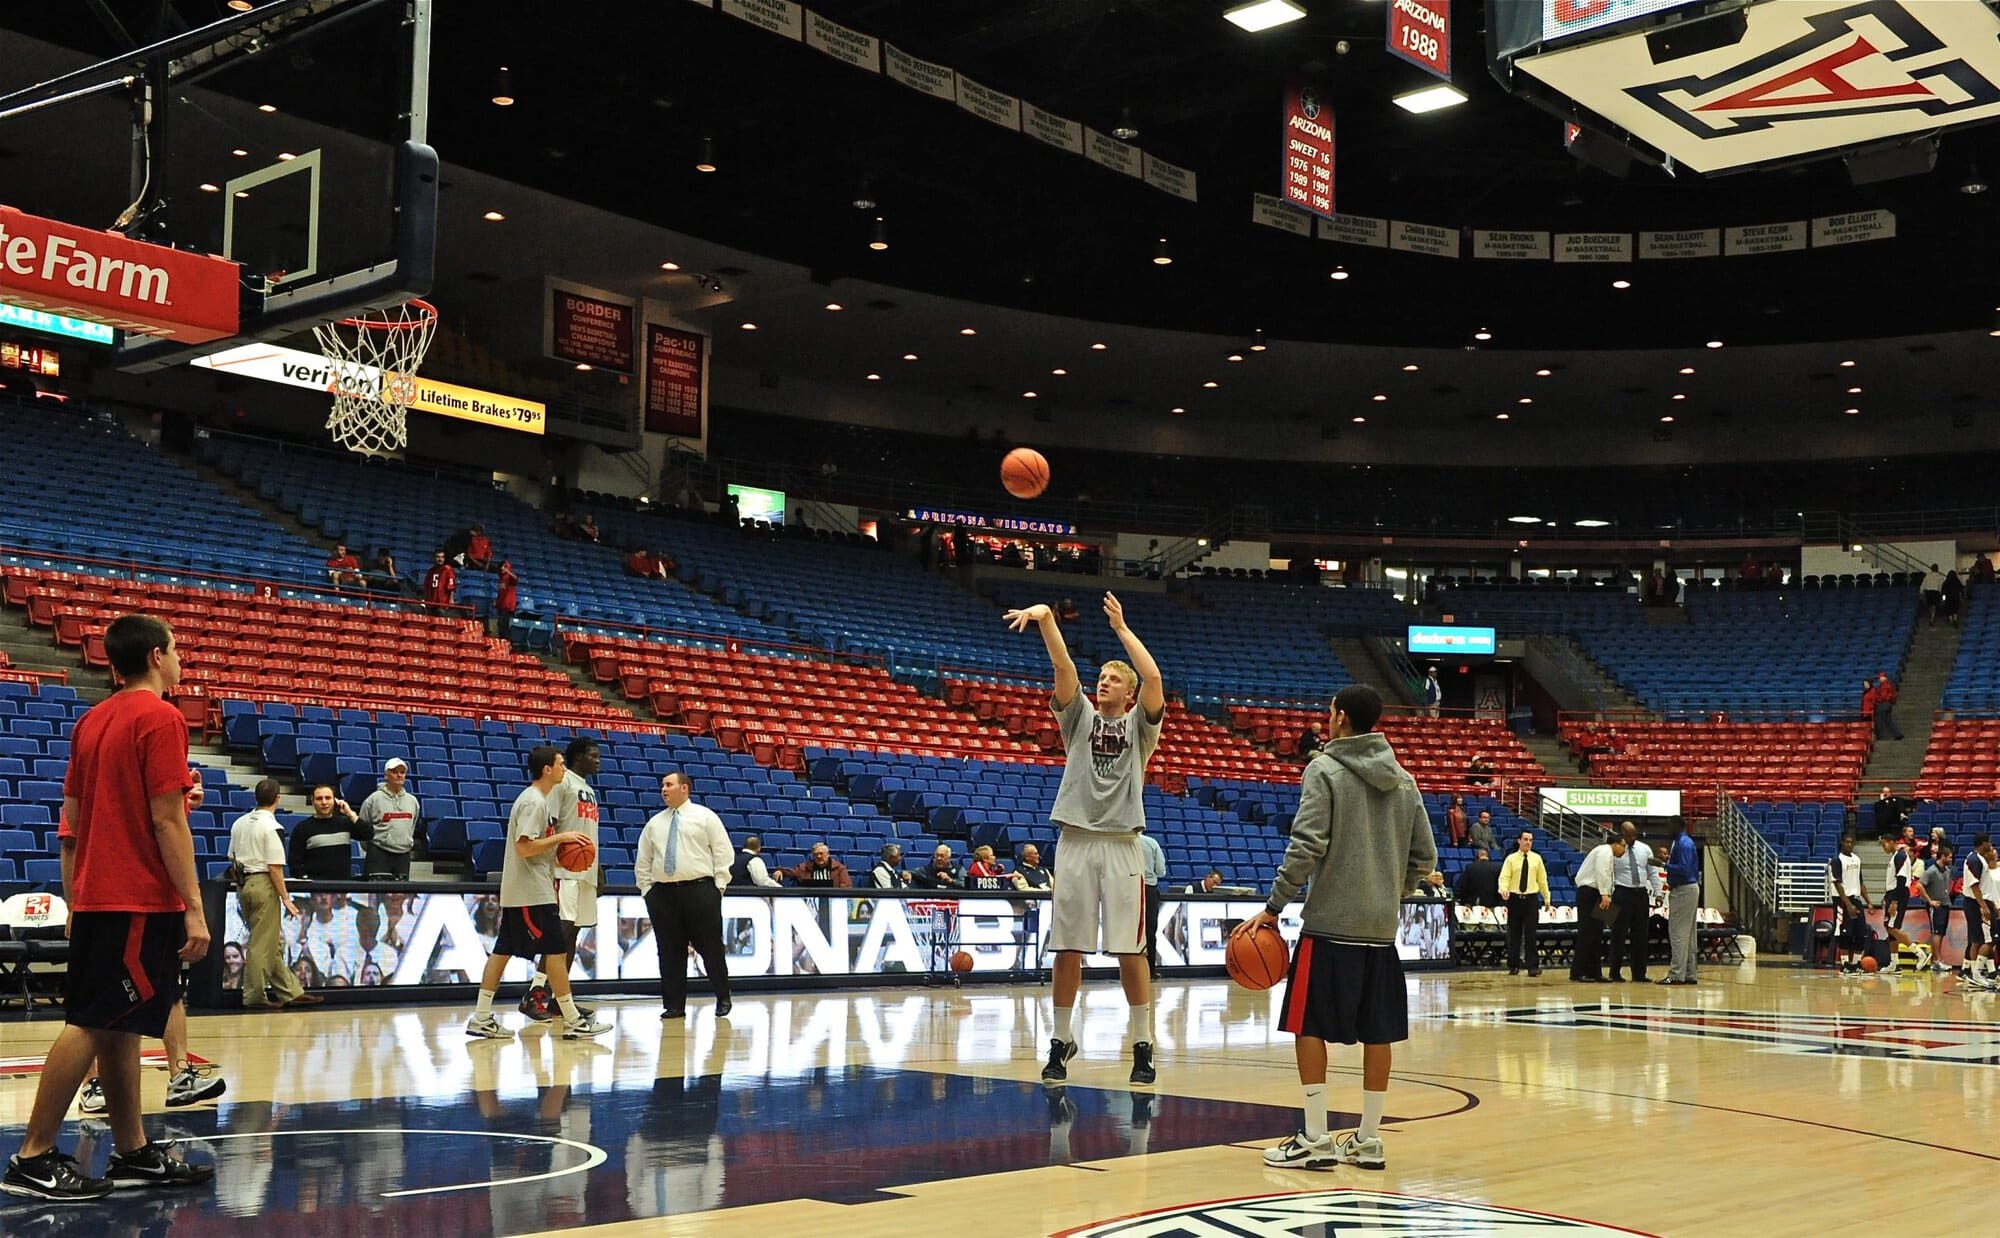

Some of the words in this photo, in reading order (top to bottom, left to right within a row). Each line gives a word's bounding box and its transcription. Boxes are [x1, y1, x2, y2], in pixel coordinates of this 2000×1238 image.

[1393, 0, 1446, 33] ARIZONA
[815, 30, 869, 58] M-BASKETBALL
[835, 25, 871, 48] GARDNER
[1401, 25, 1439, 61] 1988
[894, 62, 943, 87] M-BASKETBALL
[913, 57, 952, 80] JEFFERSON
[1289, 115, 1332, 143] ARIZONA
[1289, 139, 1319, 159] SWEET
[1320, 152, 1330, 165] 16
[1289, 156, 1308, 172] 1976
[1313, 164, 1330, 181] 1988
[1289, 171, 1308, 187] 1989
[1313, 179, 1329, 195] 1991
[1289, 186, 1308, 202] 1994
[1312, 194, 1330, 210] 1996
[1352, 216, 1377, 228] REEVES
[1828, 215, 1846, 228] BOB
[1847, 212, 1878, 225] ELLIOTT
[1328, 224, 1376, 238] M-BASKETBALL
[1405, 224, 1425, 235] CHRIS
[1427, 228, 1447, 239] MILLS
[1489, 232, 1508, 242] SEAN
[1510, 233, 1535, 242] ROOKS
[1654, 232, 1675, 242] SEAN
[1676, 231, 1705, 242] ELLIOTT
[1742, 226, 1767, 237] STEVE
[1768, 225, 1789, 235] KERR
[1823, 222, 1884, 237] M-BASKETBALL
[1400, 234, 1449, 248] M-BASKETBALL
[1567, 235, 1582, 245] JUD
[1583, 235, 1621, 245] BUECHLER
[1649, 241, 1708, 250] M-BASKETBALL
[1736, 235, 1794, 246] M-BASKETBALL
[1565, 245, 1622, 253] M-BASKETBALL
[41, 234, 169, 305] Farm
[567, 298, 621, 320] BORDER
[572, 314, 615, 329] CONFERENCE
[571, 333, 616, 348] CHAMPIONS
[587, 328, 617, 340] BASKETBALL
[653, 345, 697, 360] CONFERENCE
[659, 366, 690, 379] CHAMPIONS
[668, 360, 697, 373] BASKETBALL
[282, 362, 372, 396] verizon
[420, 389, 469, 411] Lifetime
[472, 400, 511, 420] Brakes
[921, 511, 986, 527] ARIZONA
[993, 518, 1064, 534] WILDCATS
[432, 573, 439, 588] 5
[264, 586, 272, 598] 3
[731, 642, 737, 652] 4
[1717, 715, 1723, 724] 7
[1569, 792, 1644, 806] SUNSTREET
[977, 877, 1000, 889] POSS.
[26, 896, 50, 914] 2K
